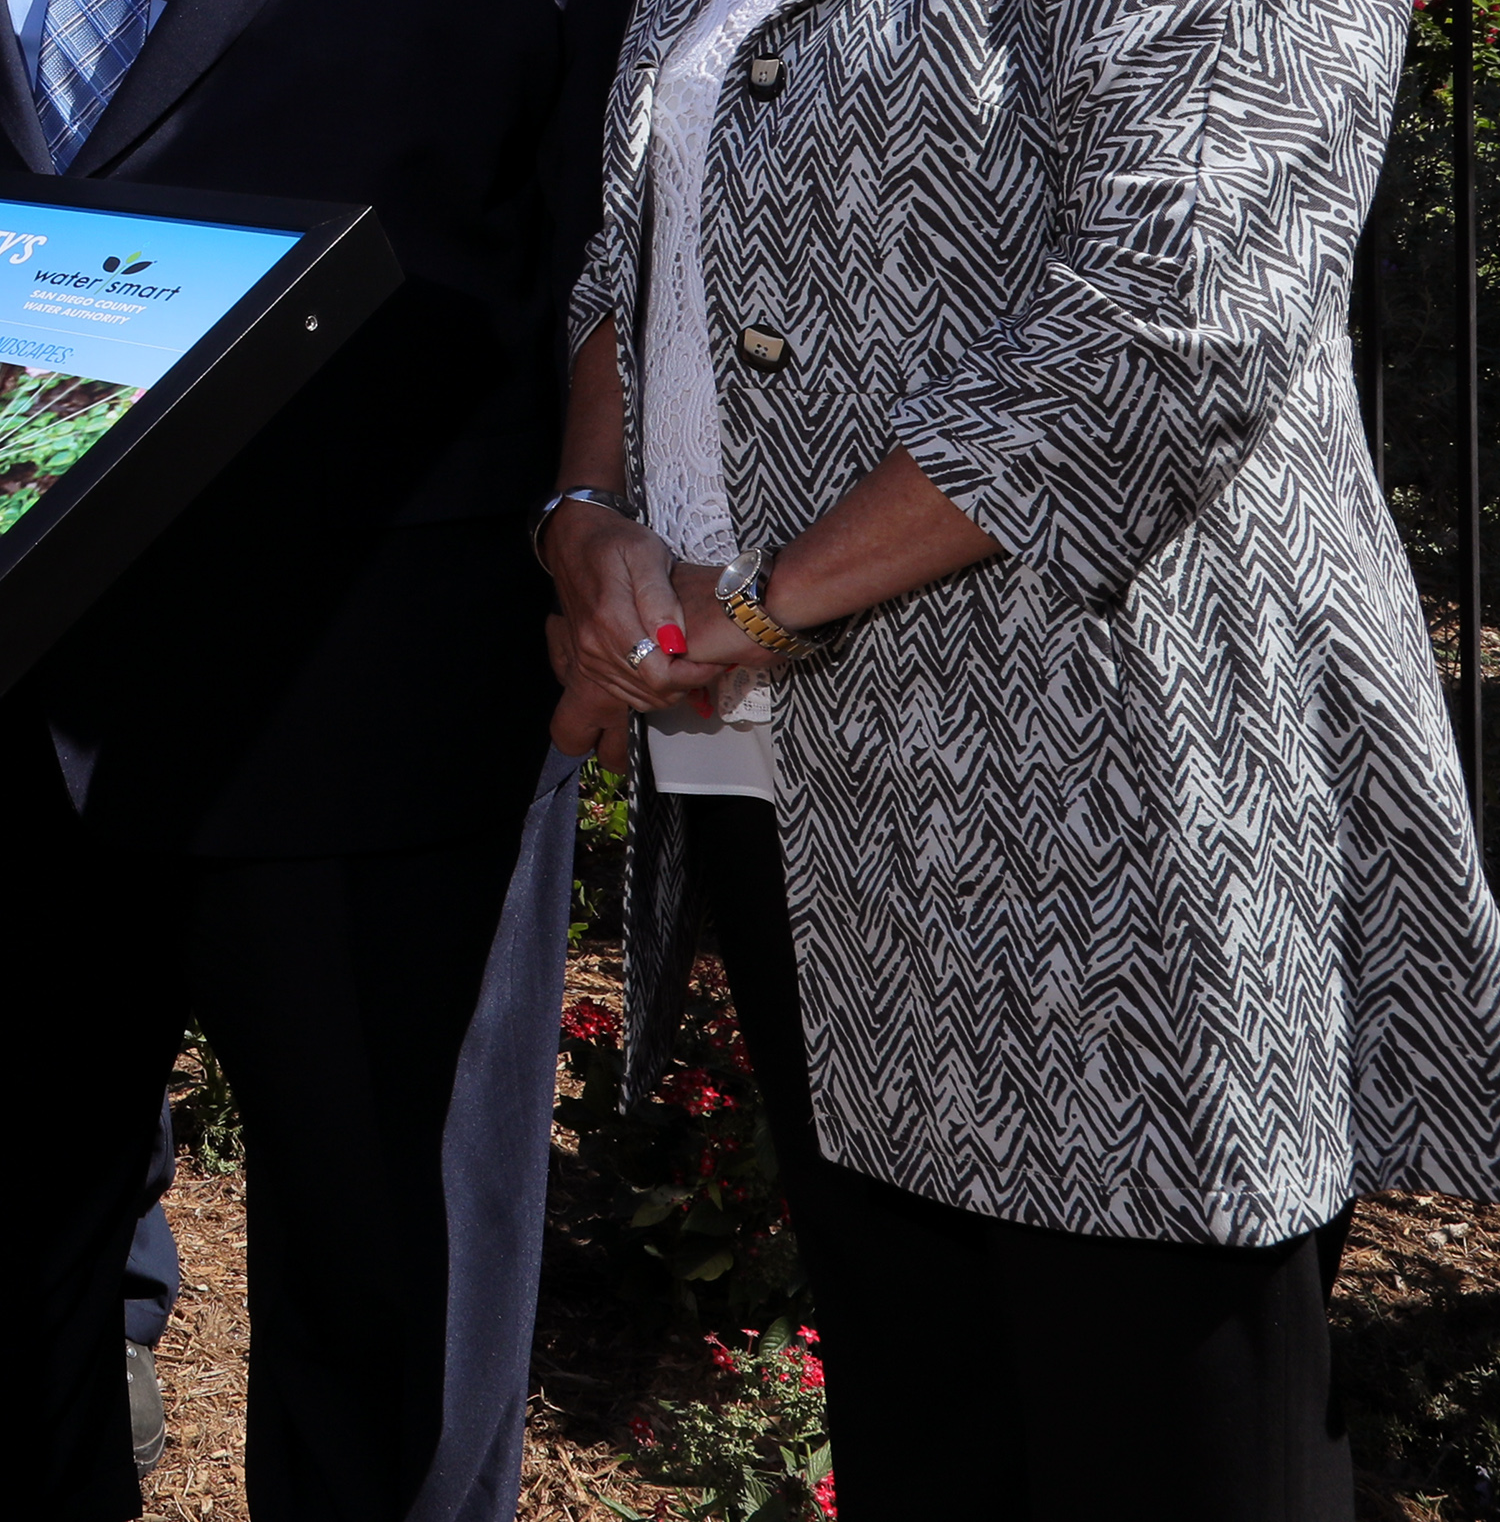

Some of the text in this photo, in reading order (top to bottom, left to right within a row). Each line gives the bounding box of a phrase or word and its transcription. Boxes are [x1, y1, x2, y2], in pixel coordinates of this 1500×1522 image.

[34, 270, 182, 302] water smart
[23, 301, 131, 325] WATER AUTHORITY
[29, 289, 147, 314] SAN DIEGO COUNTY
